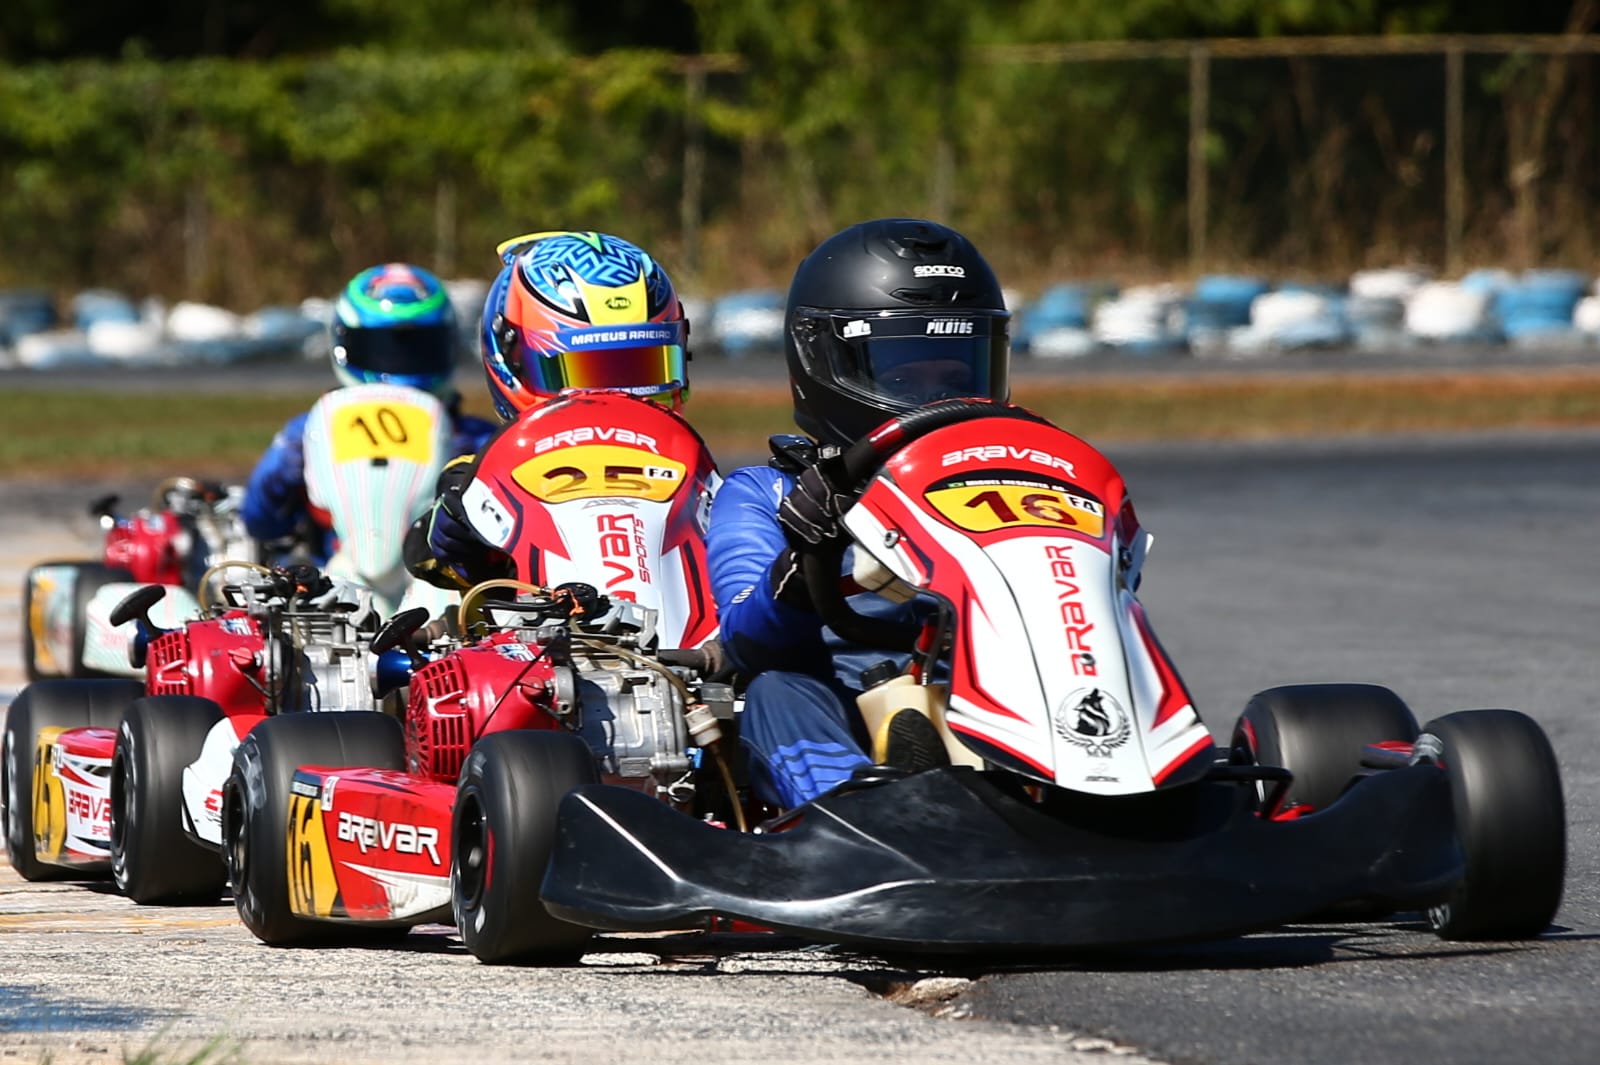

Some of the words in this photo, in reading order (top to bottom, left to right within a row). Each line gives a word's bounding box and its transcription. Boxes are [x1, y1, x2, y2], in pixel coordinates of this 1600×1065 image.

[913, 265, 965, 277] sparco
[571, 331, 627, 346] MATEUS
[926, 321, 974, 335] PILOTOS
[351, 408, 408, 446] 10
[542, 465, 652, 497] 25
[648, 468, 674, 479] F4
[964, 490, 1078, 526] 16
[634, 518, 651, 585] SPORTS
